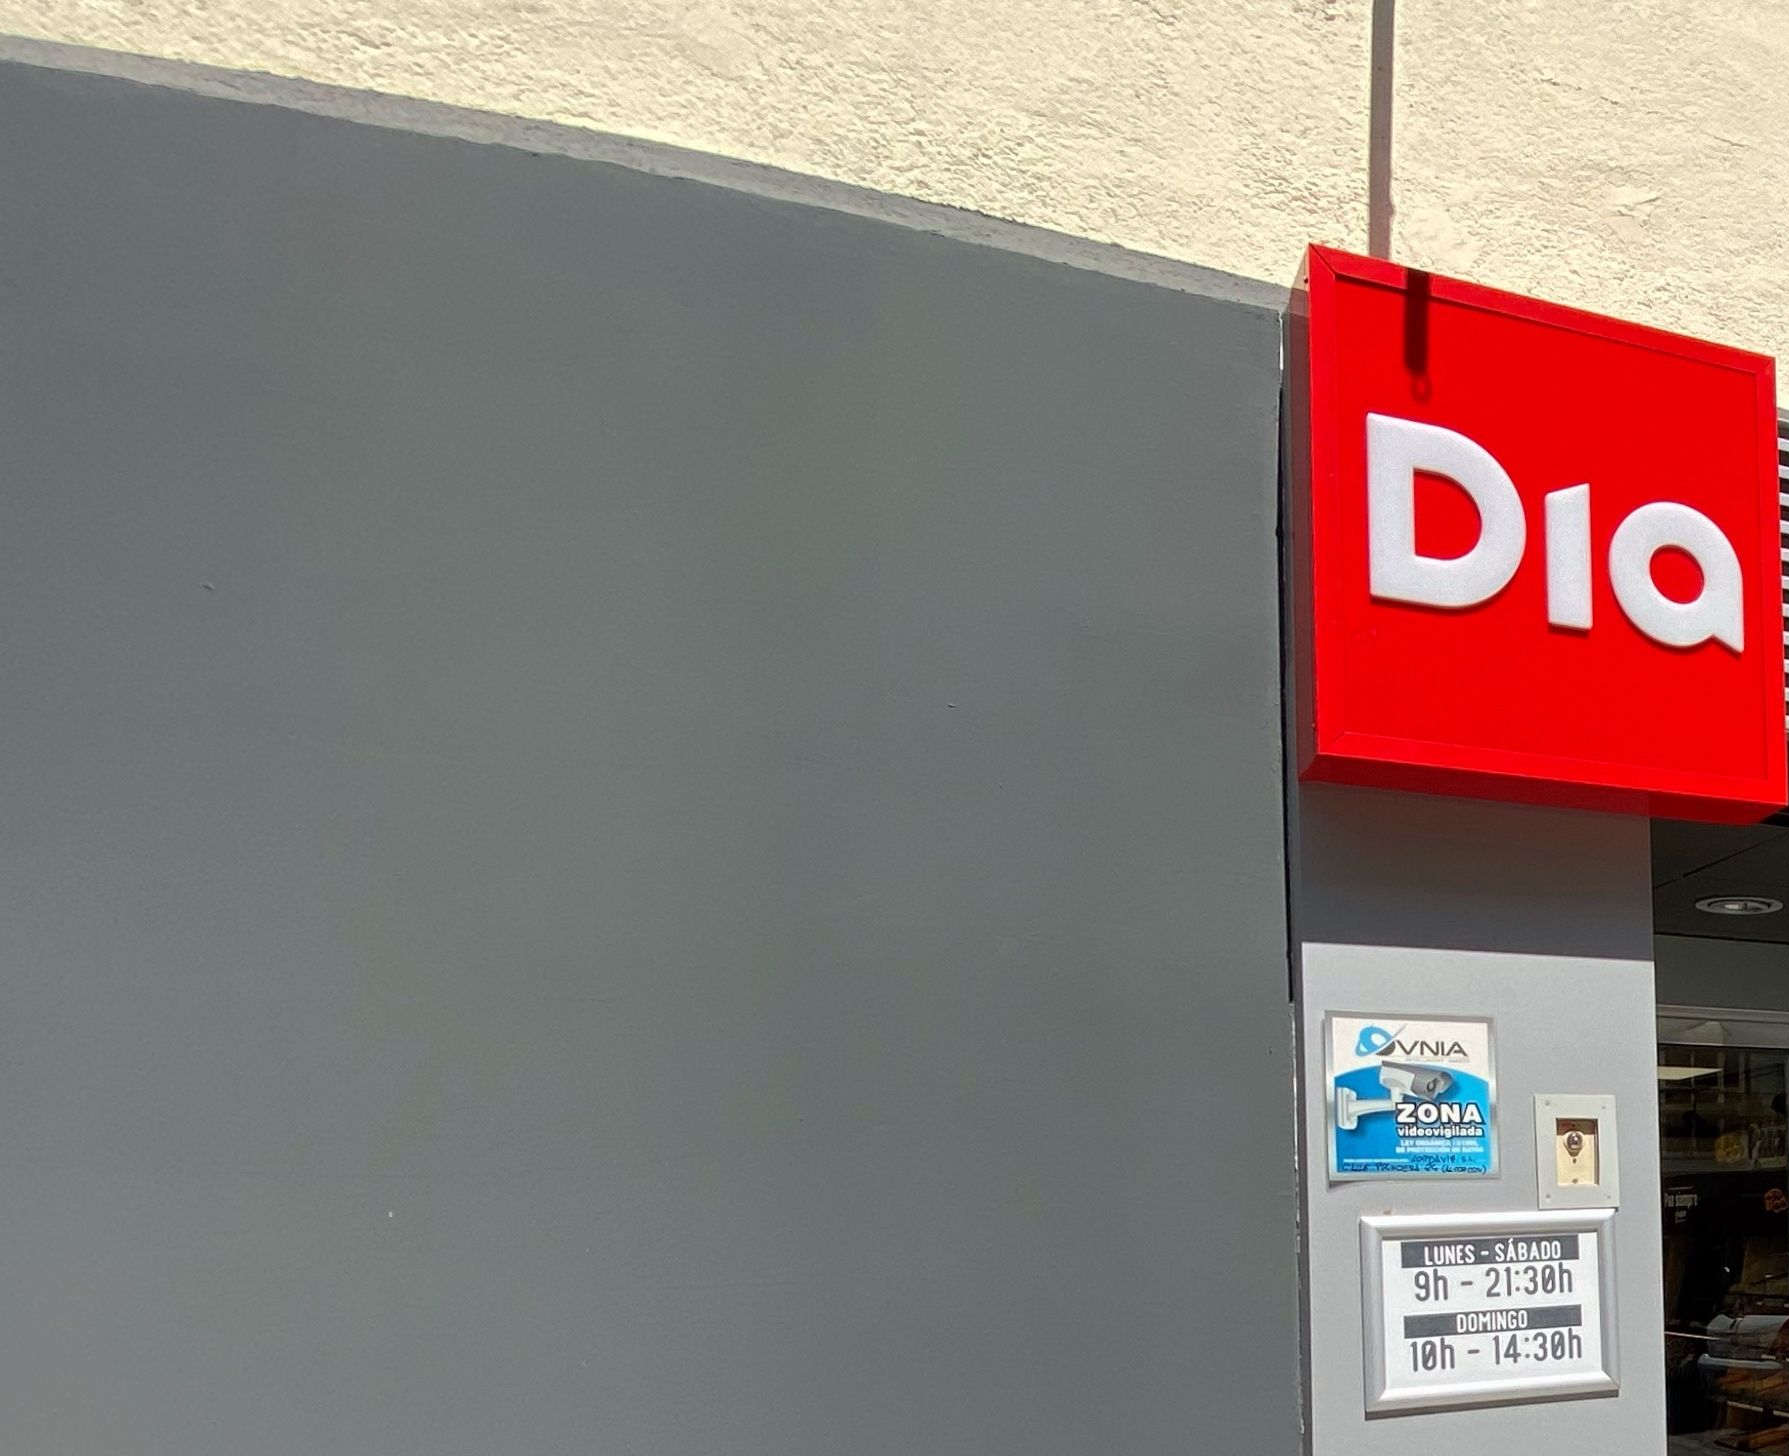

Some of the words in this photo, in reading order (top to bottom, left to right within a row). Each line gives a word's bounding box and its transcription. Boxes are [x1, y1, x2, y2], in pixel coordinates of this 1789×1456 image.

[1396, 1101, 1484, 1124] ZONA
[1397, 1125, 1484, 1138] videovigilada
[1424, 1245, 1475, 1266] LUNES
[1494, 1237, 1562, 1263] SÁBADO
[1414, 1268, 1449, 1302] 9h
[1485, 1262, 1573, 1298] 21:30h
[1456, 1310, 1528, 1333] DOMINGO
[1410, 1337, 1455, 1372] 10h
[1492, 1327, 1582, 1365] 14:30h
